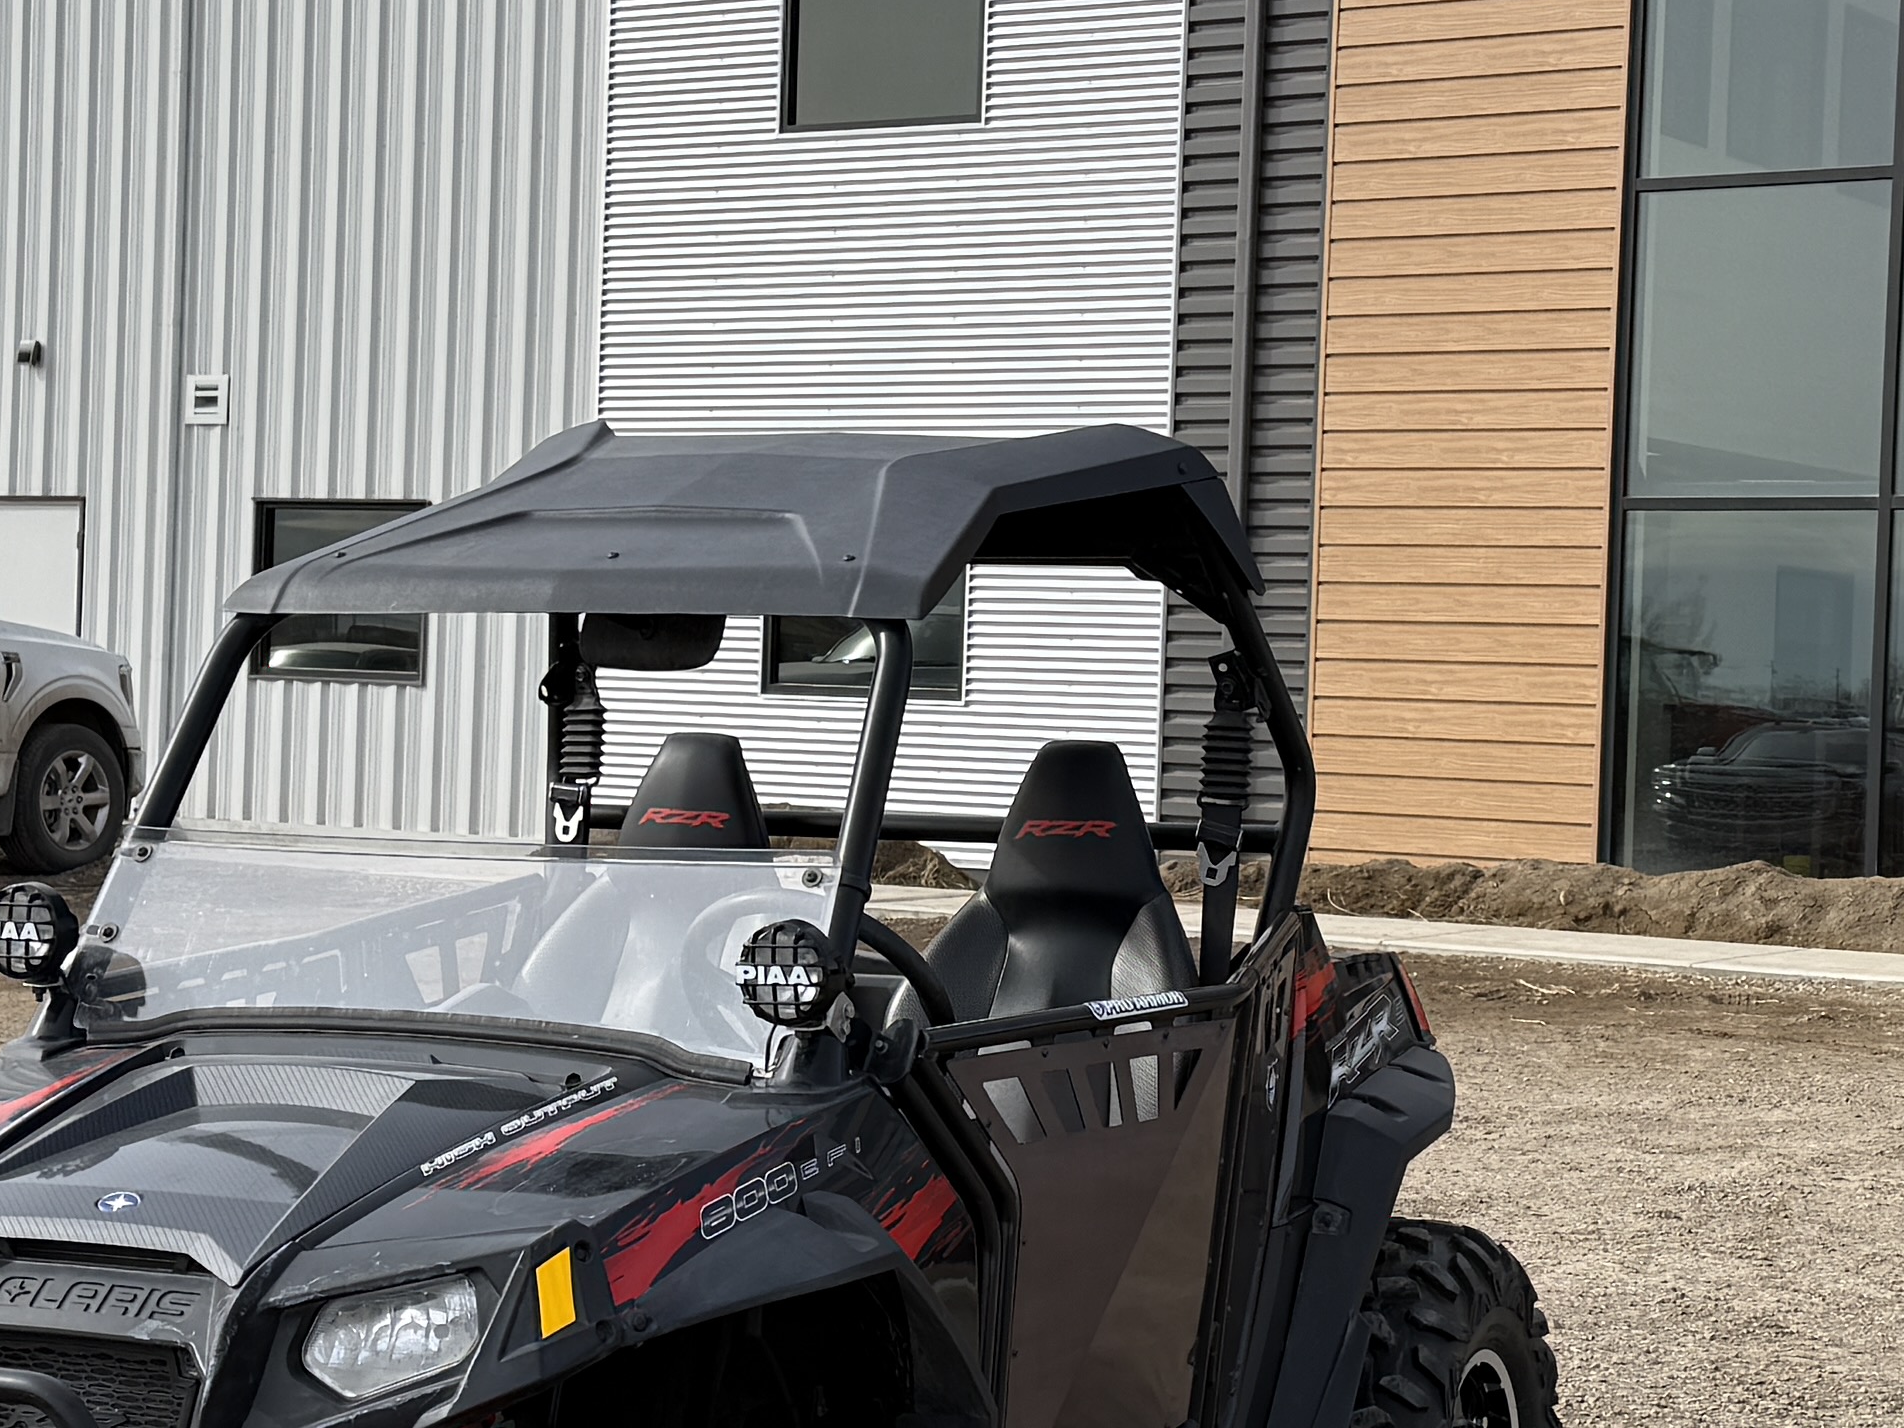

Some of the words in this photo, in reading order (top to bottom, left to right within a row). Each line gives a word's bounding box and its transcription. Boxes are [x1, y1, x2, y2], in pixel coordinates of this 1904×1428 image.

[638, 807, 731, 828] RZR
[1014, 820, 1117, 840] RZR
[735, 965, 811, 985] PIAA
[420, 1131, 496, 1176] HIGH
[500, 1076, 618, 1135] OUTPUT
[700, 1161, 798, 1240] 800
